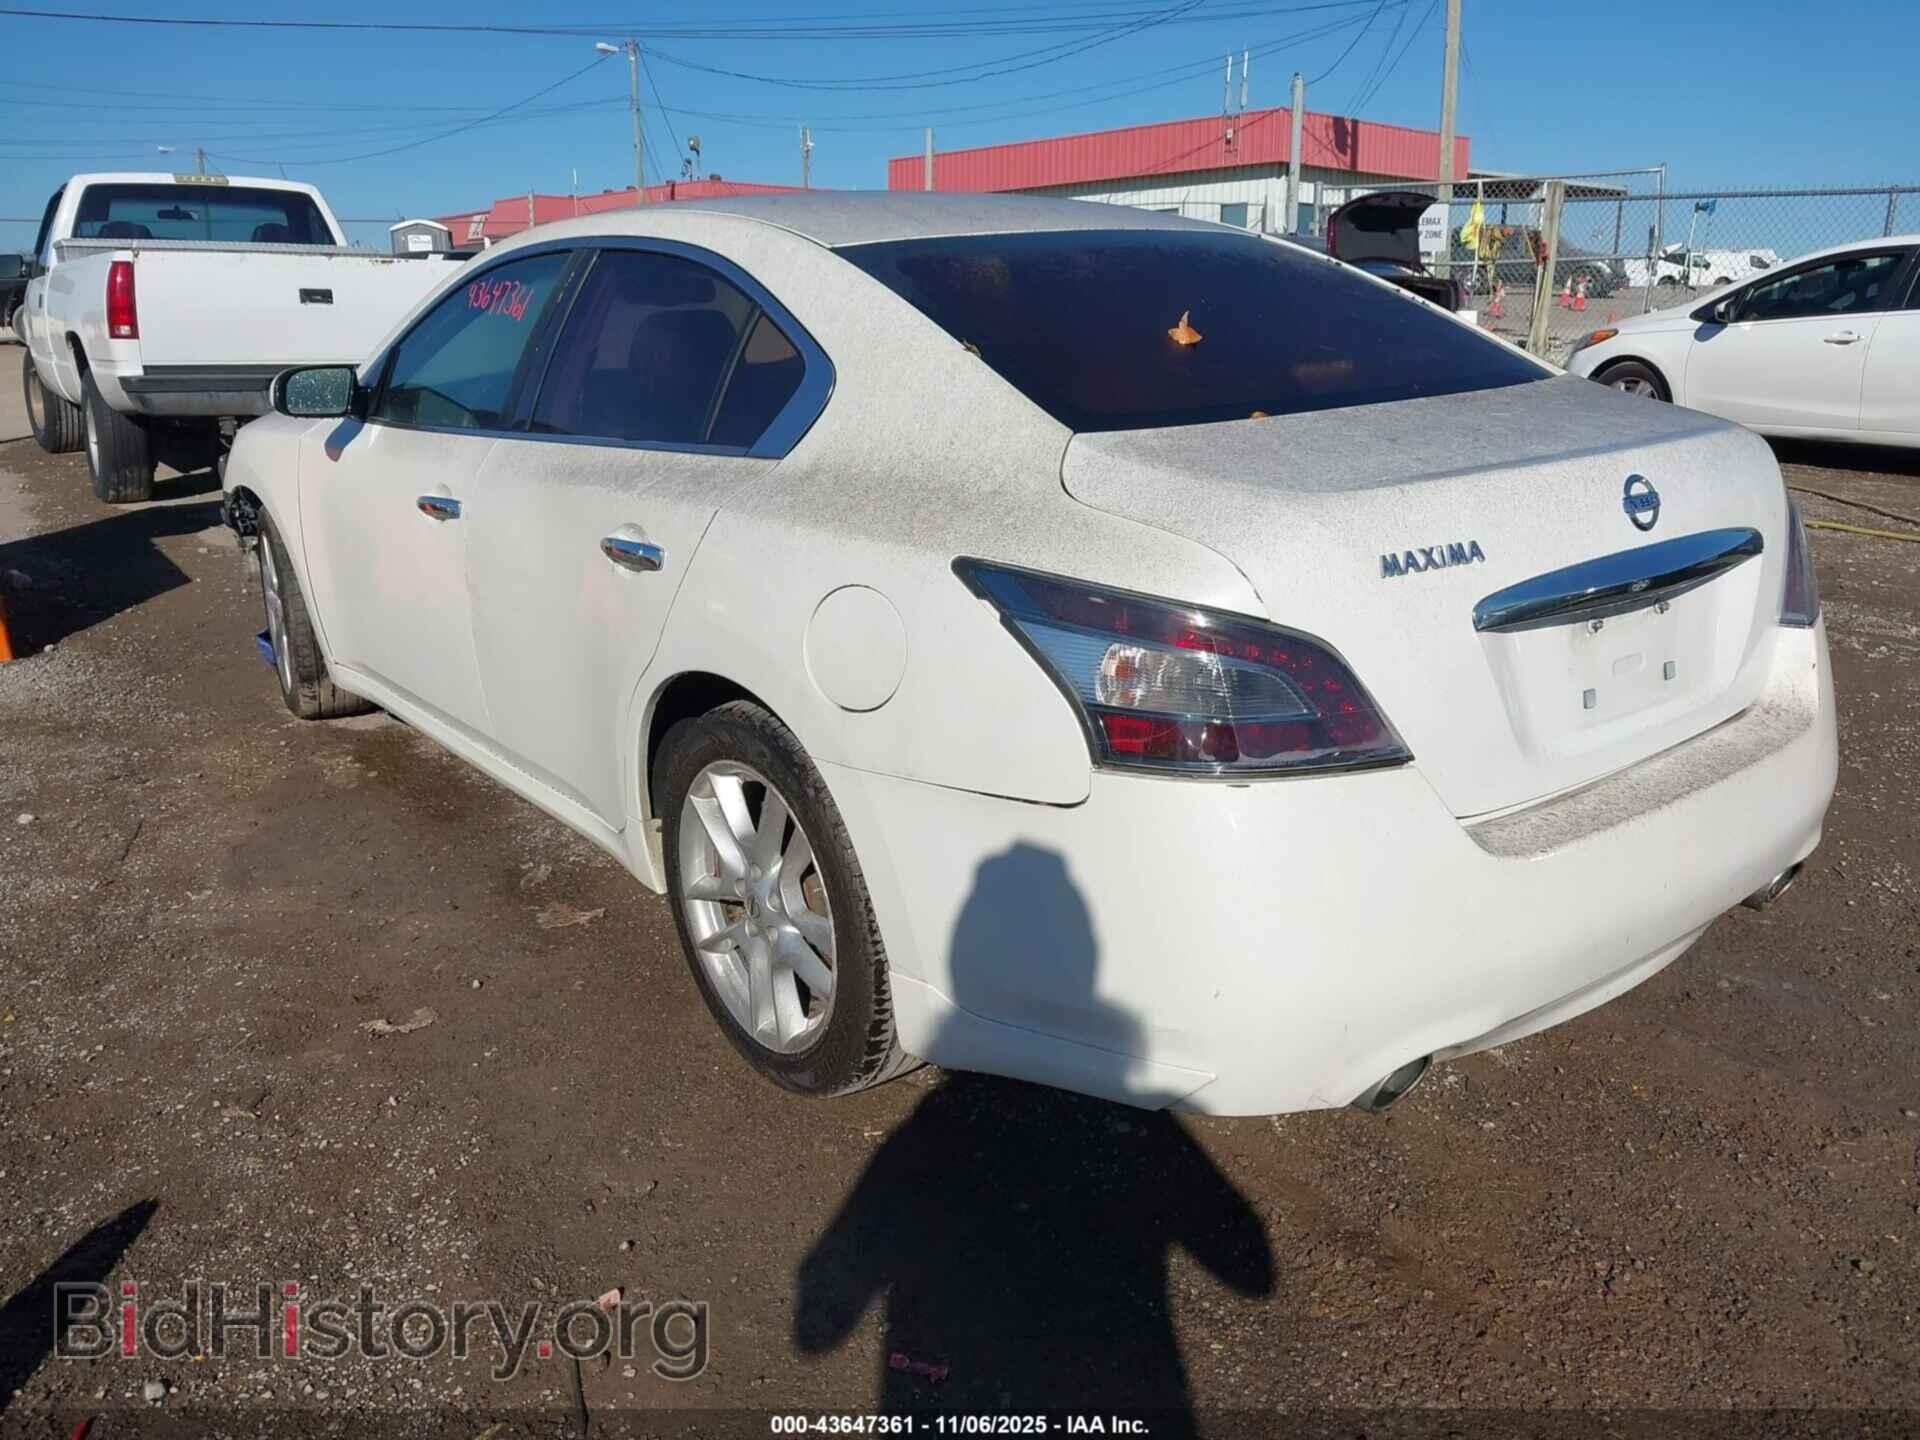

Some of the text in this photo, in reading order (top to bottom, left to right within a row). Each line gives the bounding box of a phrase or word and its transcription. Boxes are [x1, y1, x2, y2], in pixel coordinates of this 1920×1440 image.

[1420, 216, 1442, 226] EMAX
[1424, 229, 1443, 240] ZONE
[1380, 540, 1485, 578] MAXIMA
